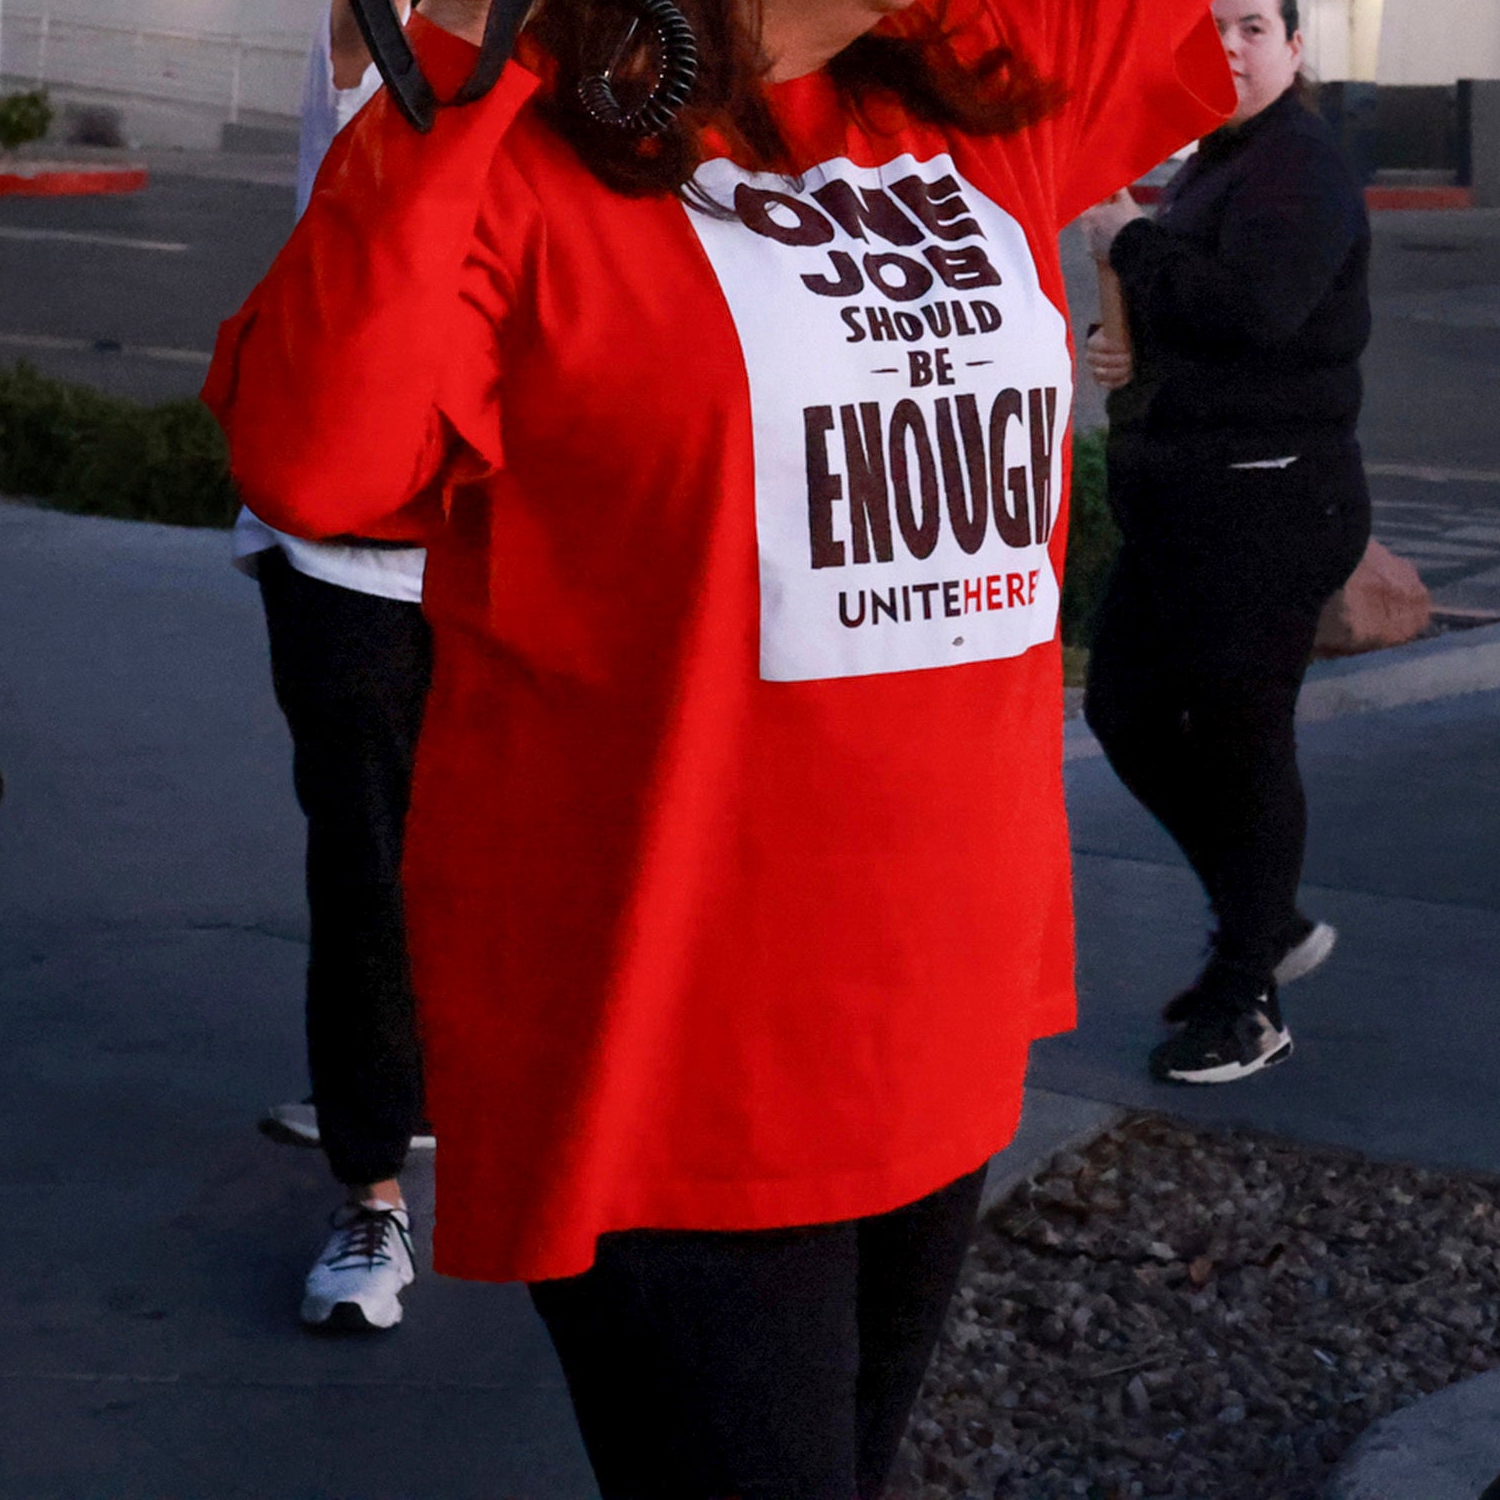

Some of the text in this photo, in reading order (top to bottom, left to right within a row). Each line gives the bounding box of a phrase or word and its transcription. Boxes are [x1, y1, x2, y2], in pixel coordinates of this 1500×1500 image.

[734, 173, 988, 247] ONE
[800, 245, 1003, 302] JOB
[840, 300, 1003, 343] SHOULD
[908, 348, 956, 388] BE
[803, 386, 1057, 570] ENOUGH
